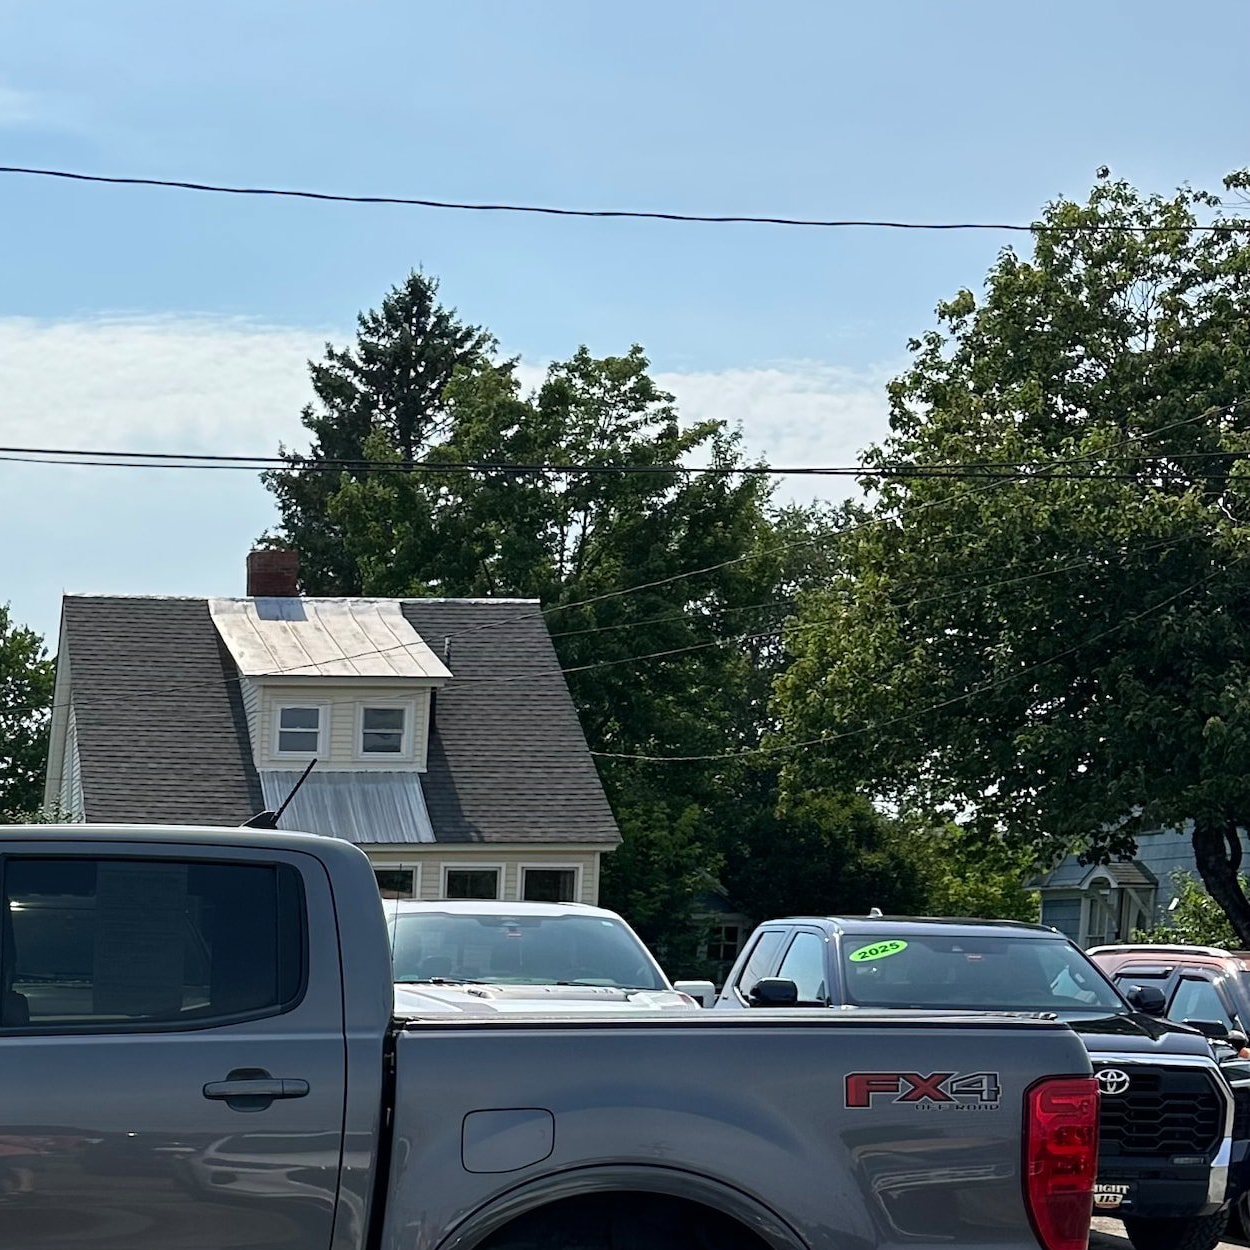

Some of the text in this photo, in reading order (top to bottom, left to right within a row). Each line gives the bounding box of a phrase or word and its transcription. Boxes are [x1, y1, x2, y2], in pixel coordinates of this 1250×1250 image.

[858, 942, 899, 959] 2025
[844, 1071, 1002, 1109] FX4
[915, 1103, 1000, 1111] OFF ROAD
